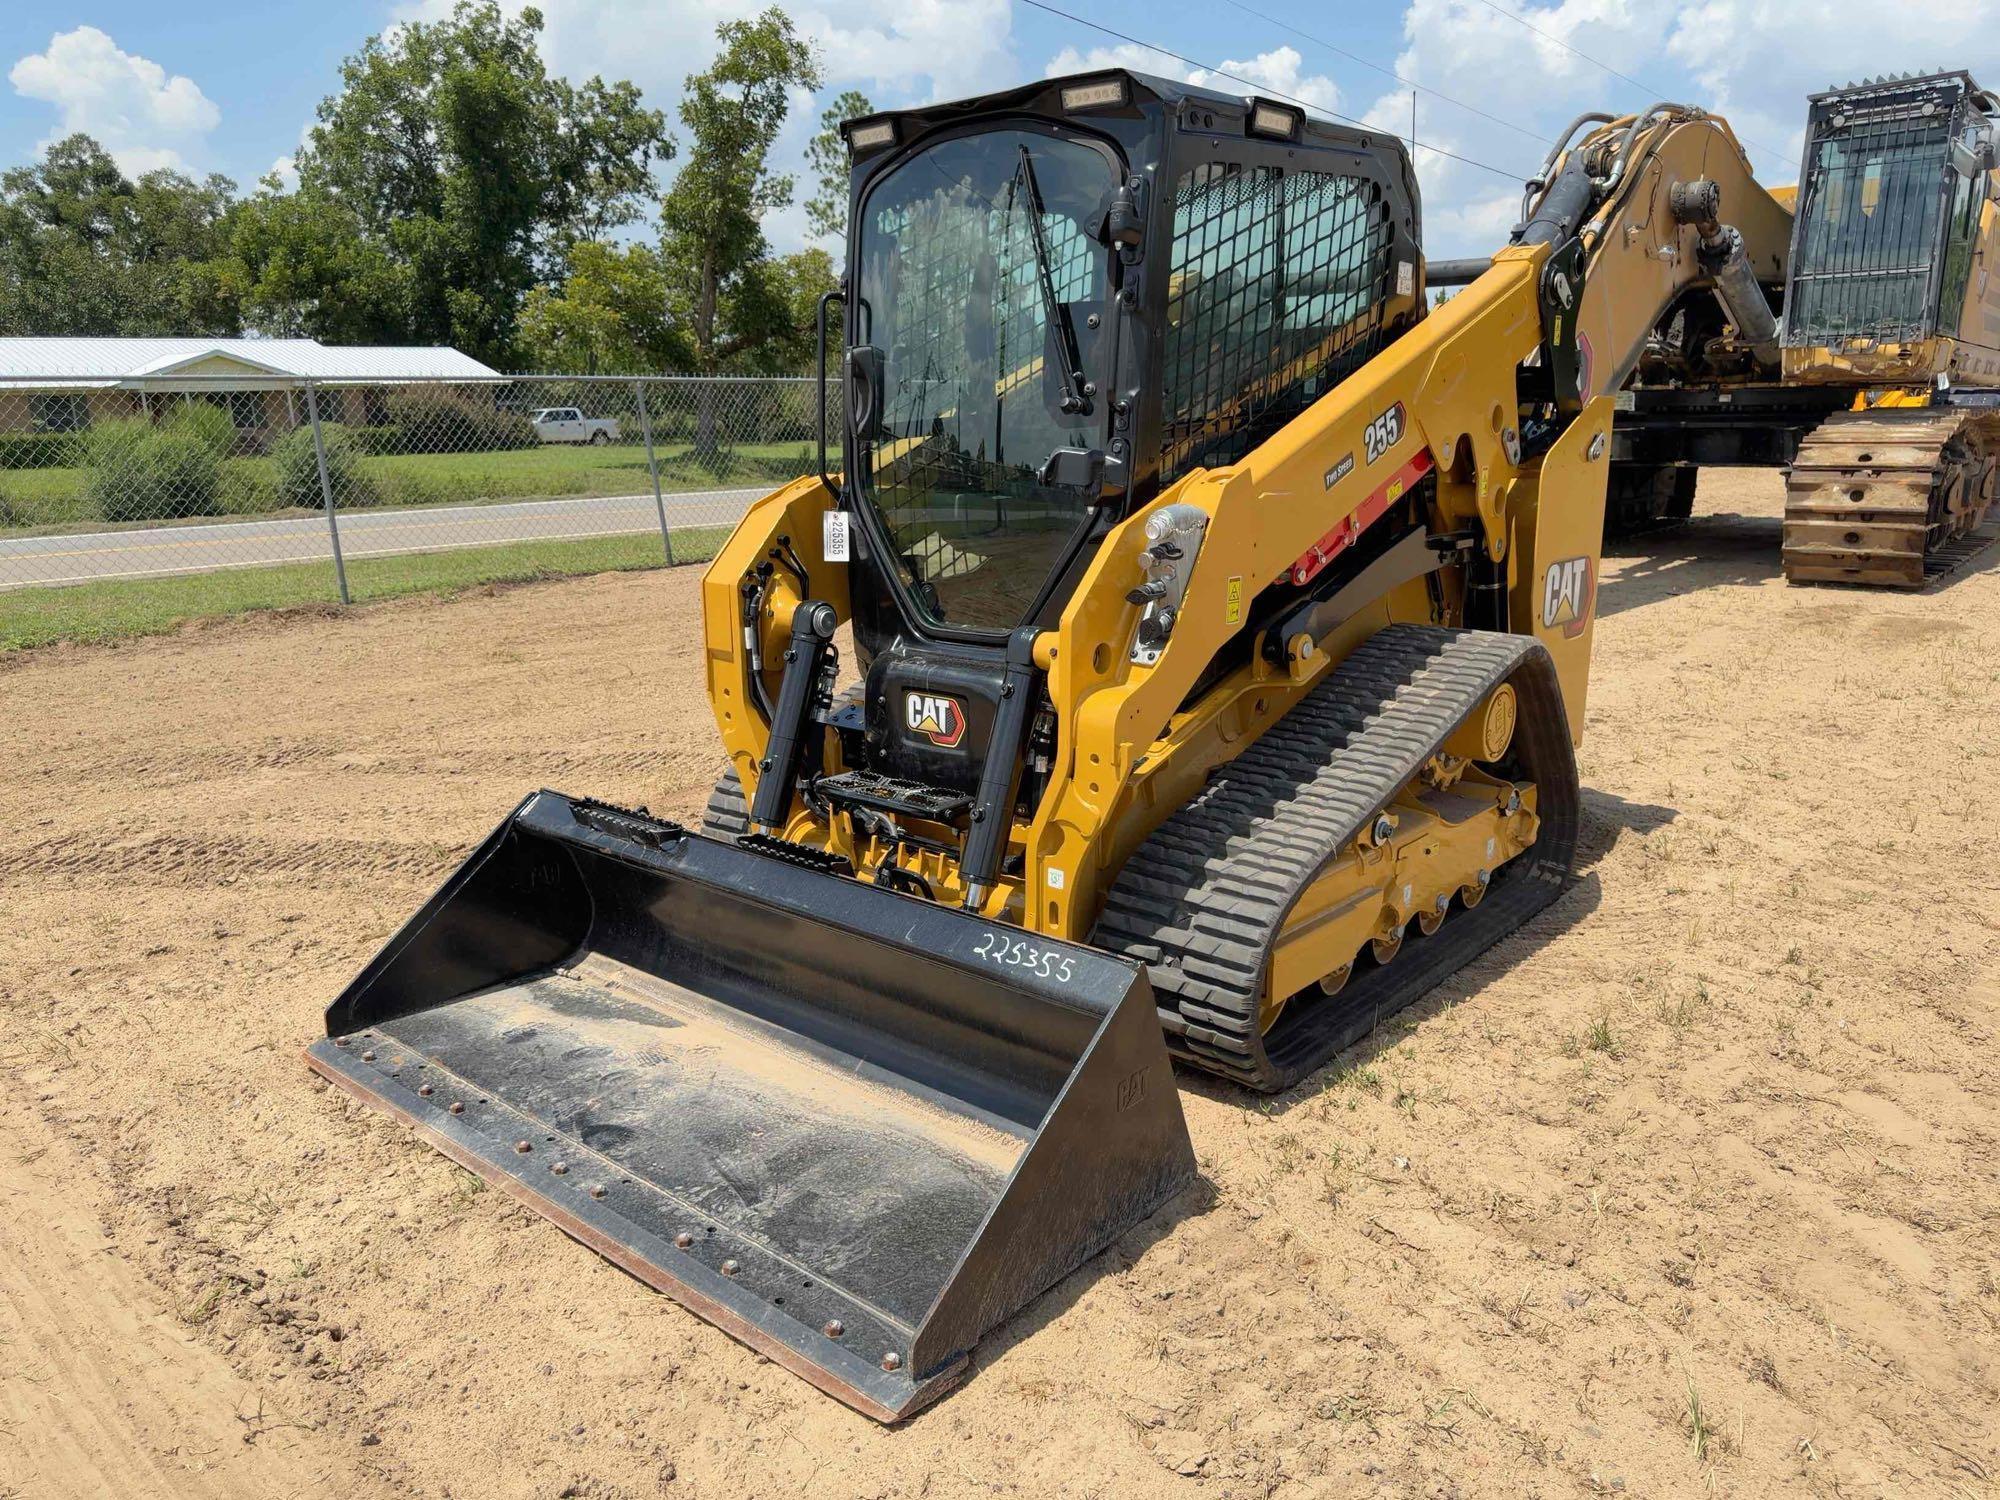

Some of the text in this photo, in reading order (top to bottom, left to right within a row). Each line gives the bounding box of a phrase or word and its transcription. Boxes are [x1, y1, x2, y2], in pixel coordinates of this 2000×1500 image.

[1365, 406, 1397, 465] 255
[832, 521, 844, 555] 225355
[1544, 558, 1586, 627] CAT
[908, 694, 950, 734] CAT
[973, 933, 1076, 983] 225355
[1116, 1065, 1150, 1113] CAT
